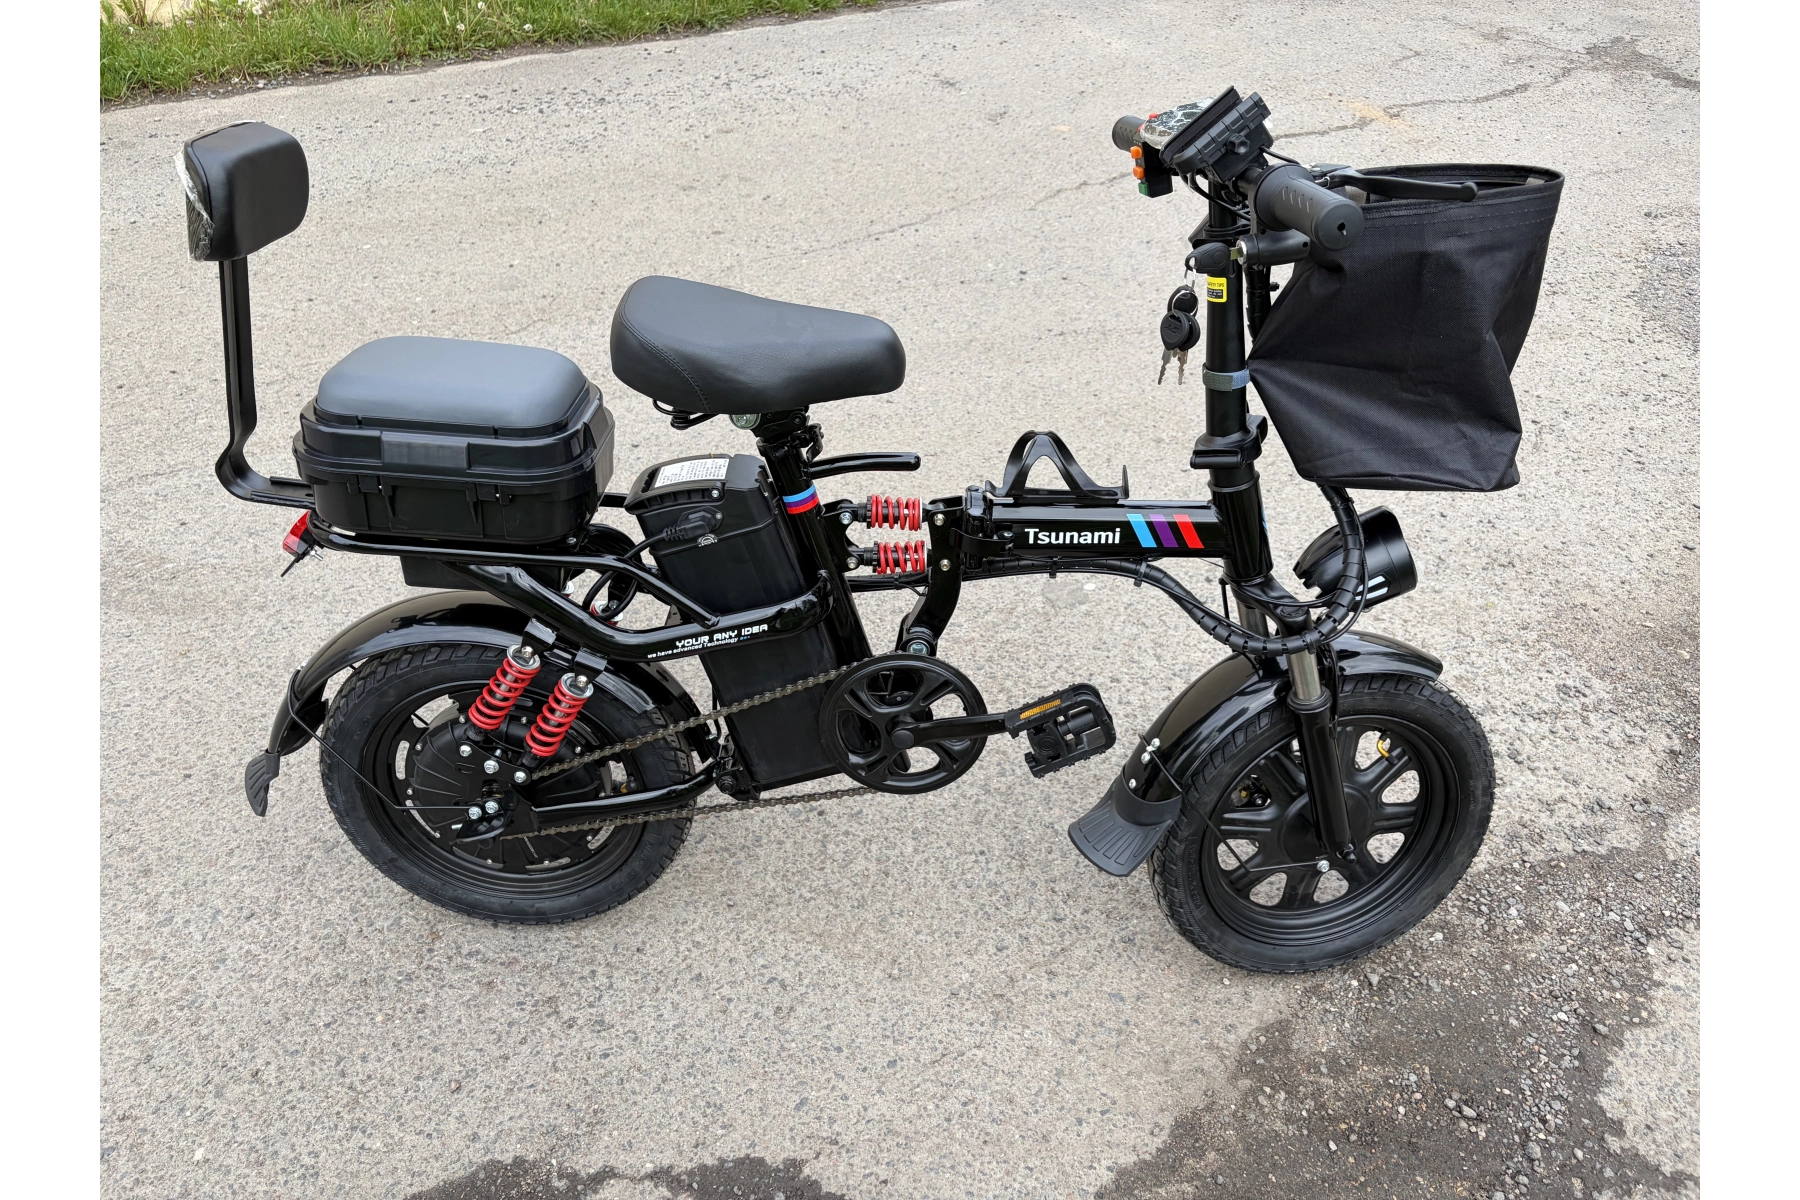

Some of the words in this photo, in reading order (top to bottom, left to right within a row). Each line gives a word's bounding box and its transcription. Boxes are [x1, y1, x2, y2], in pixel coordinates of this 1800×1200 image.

[1024, 527, 1121, 544] Tsunami
[657, 649, 672, 657] have
[673, 643, 703, 654] advanced
[704, 636, 739, 649] Technology
[676, 635, 710, 648] YOUR
[713, 630, 738, 642] ANY
[741, 624, 769, 636] IDEA
